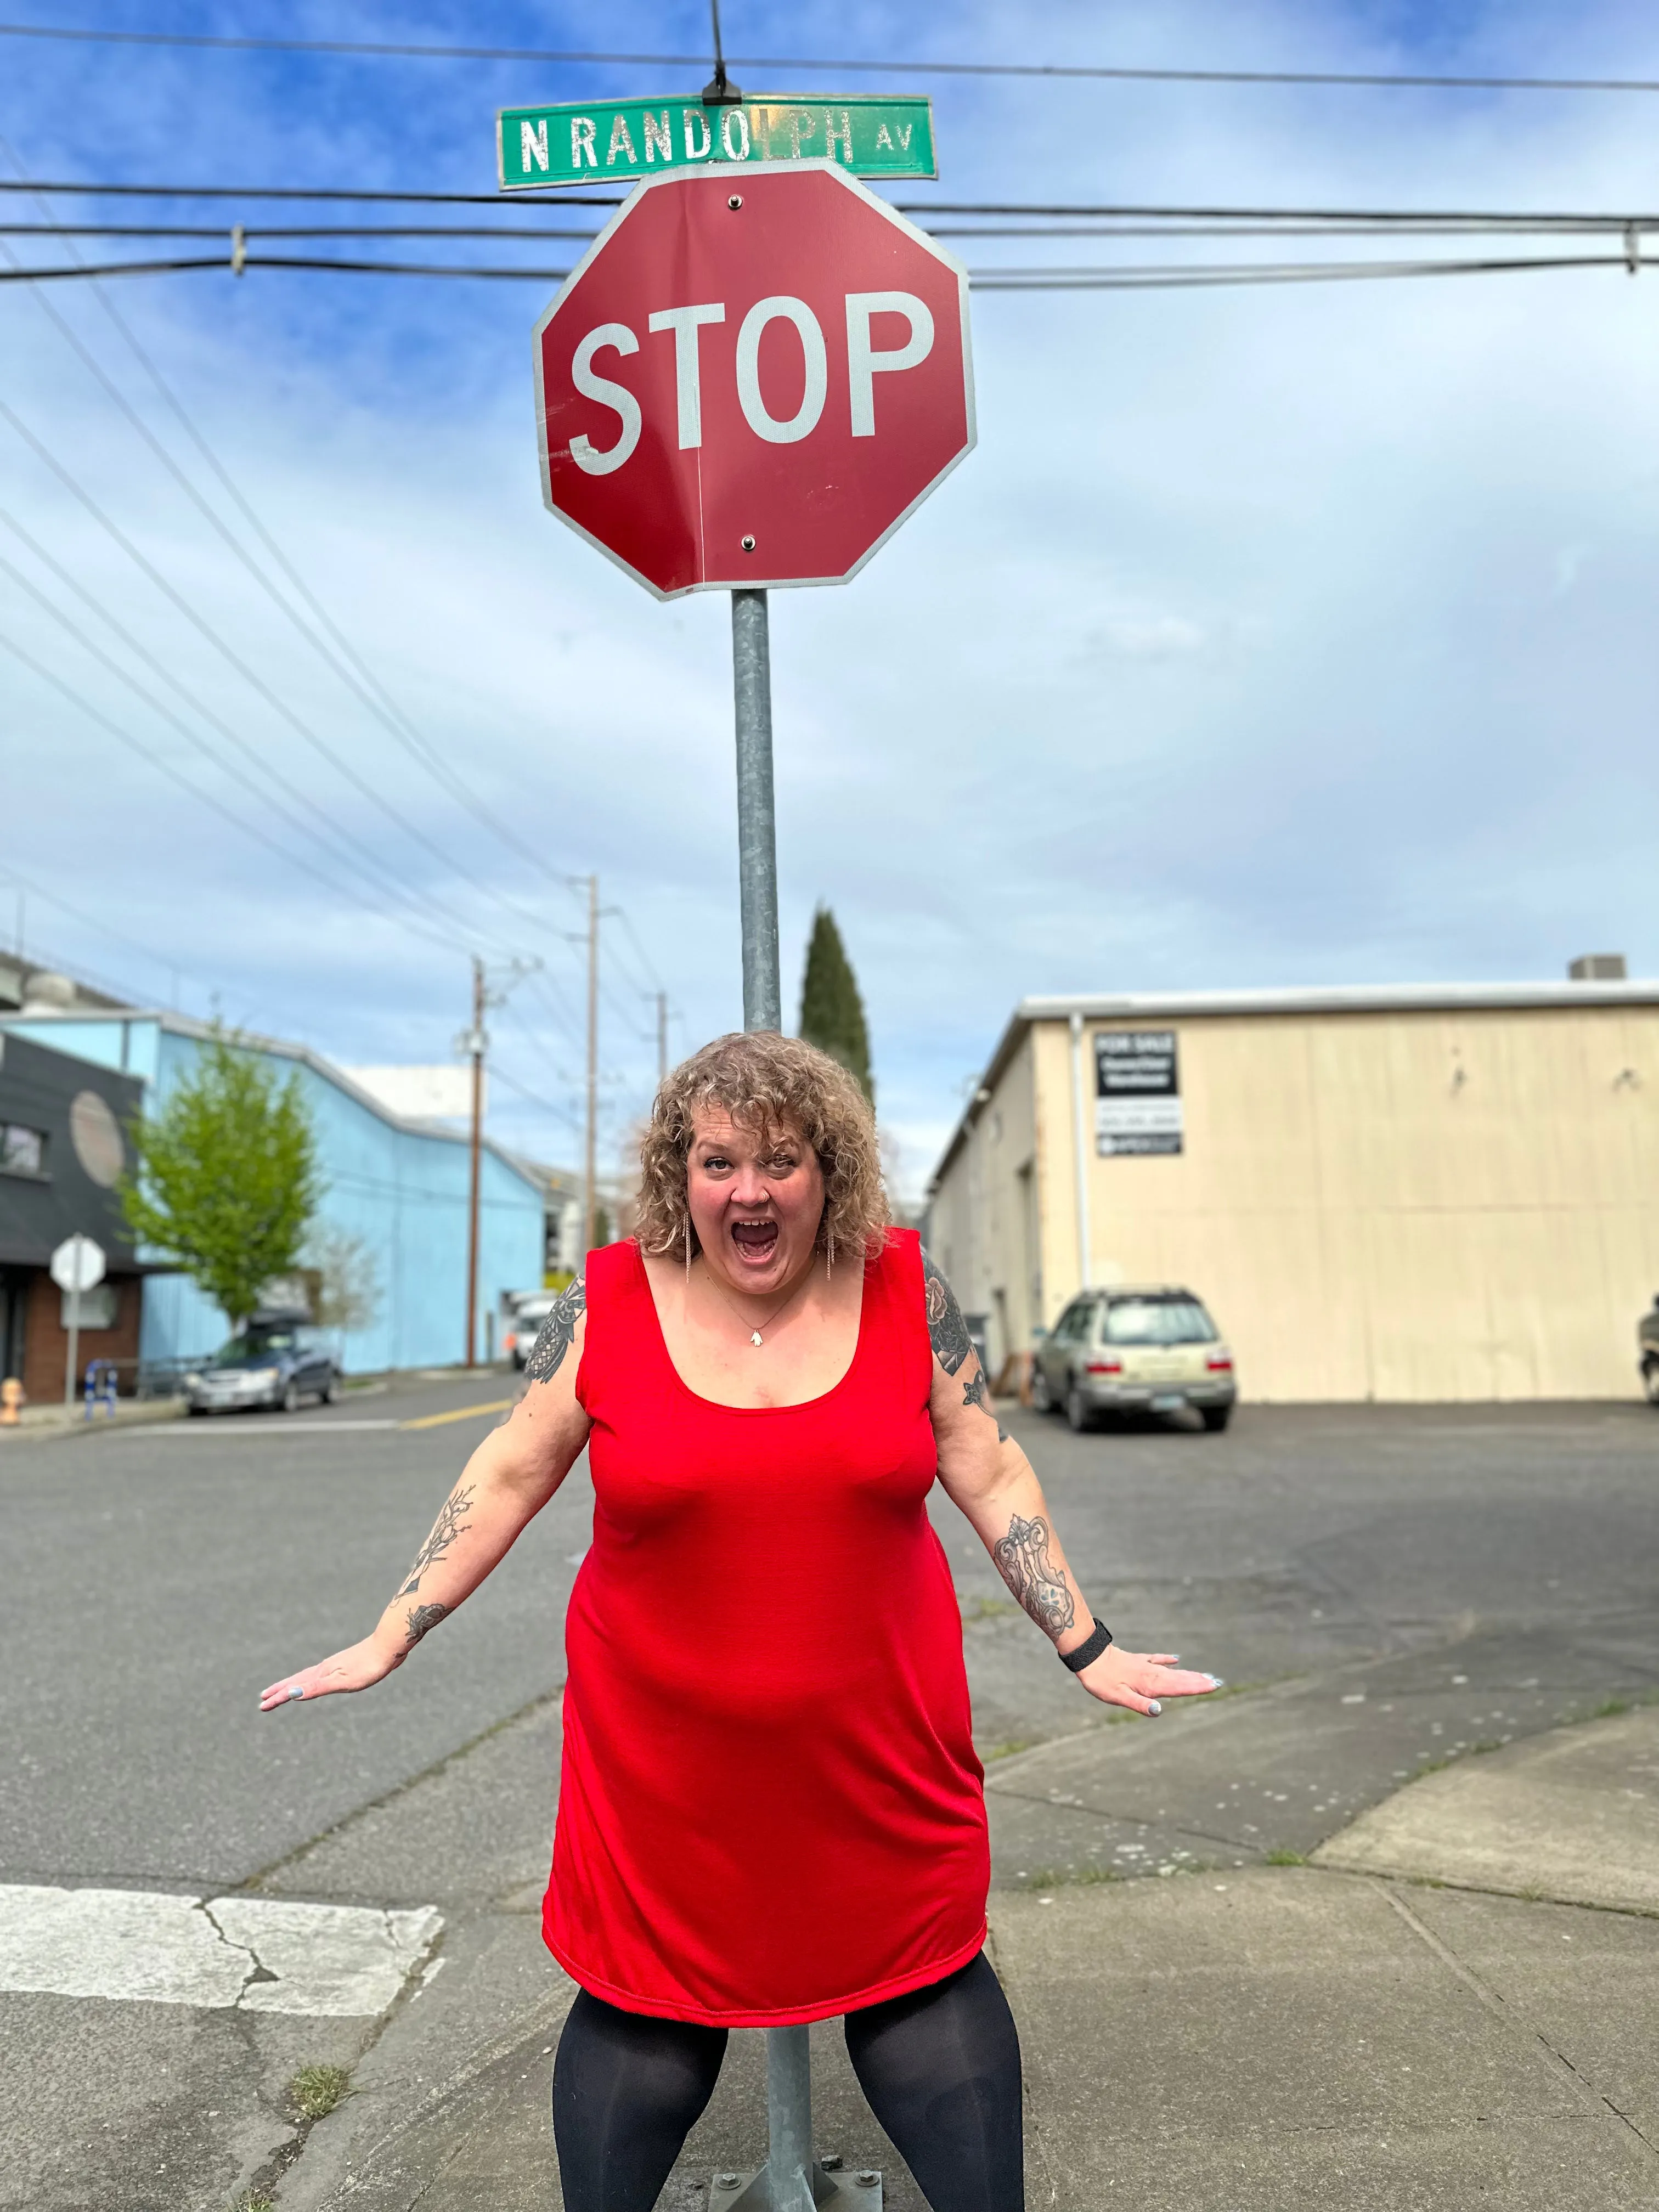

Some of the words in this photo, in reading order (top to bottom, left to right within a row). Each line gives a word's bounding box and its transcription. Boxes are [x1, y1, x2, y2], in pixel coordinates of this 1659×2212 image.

[521, 120, 549, 173] N
[571, 108, 853, 168] RANDOLPH
[876, 123, 912, 150] AV
[568, 291, 935, 476] STOP
